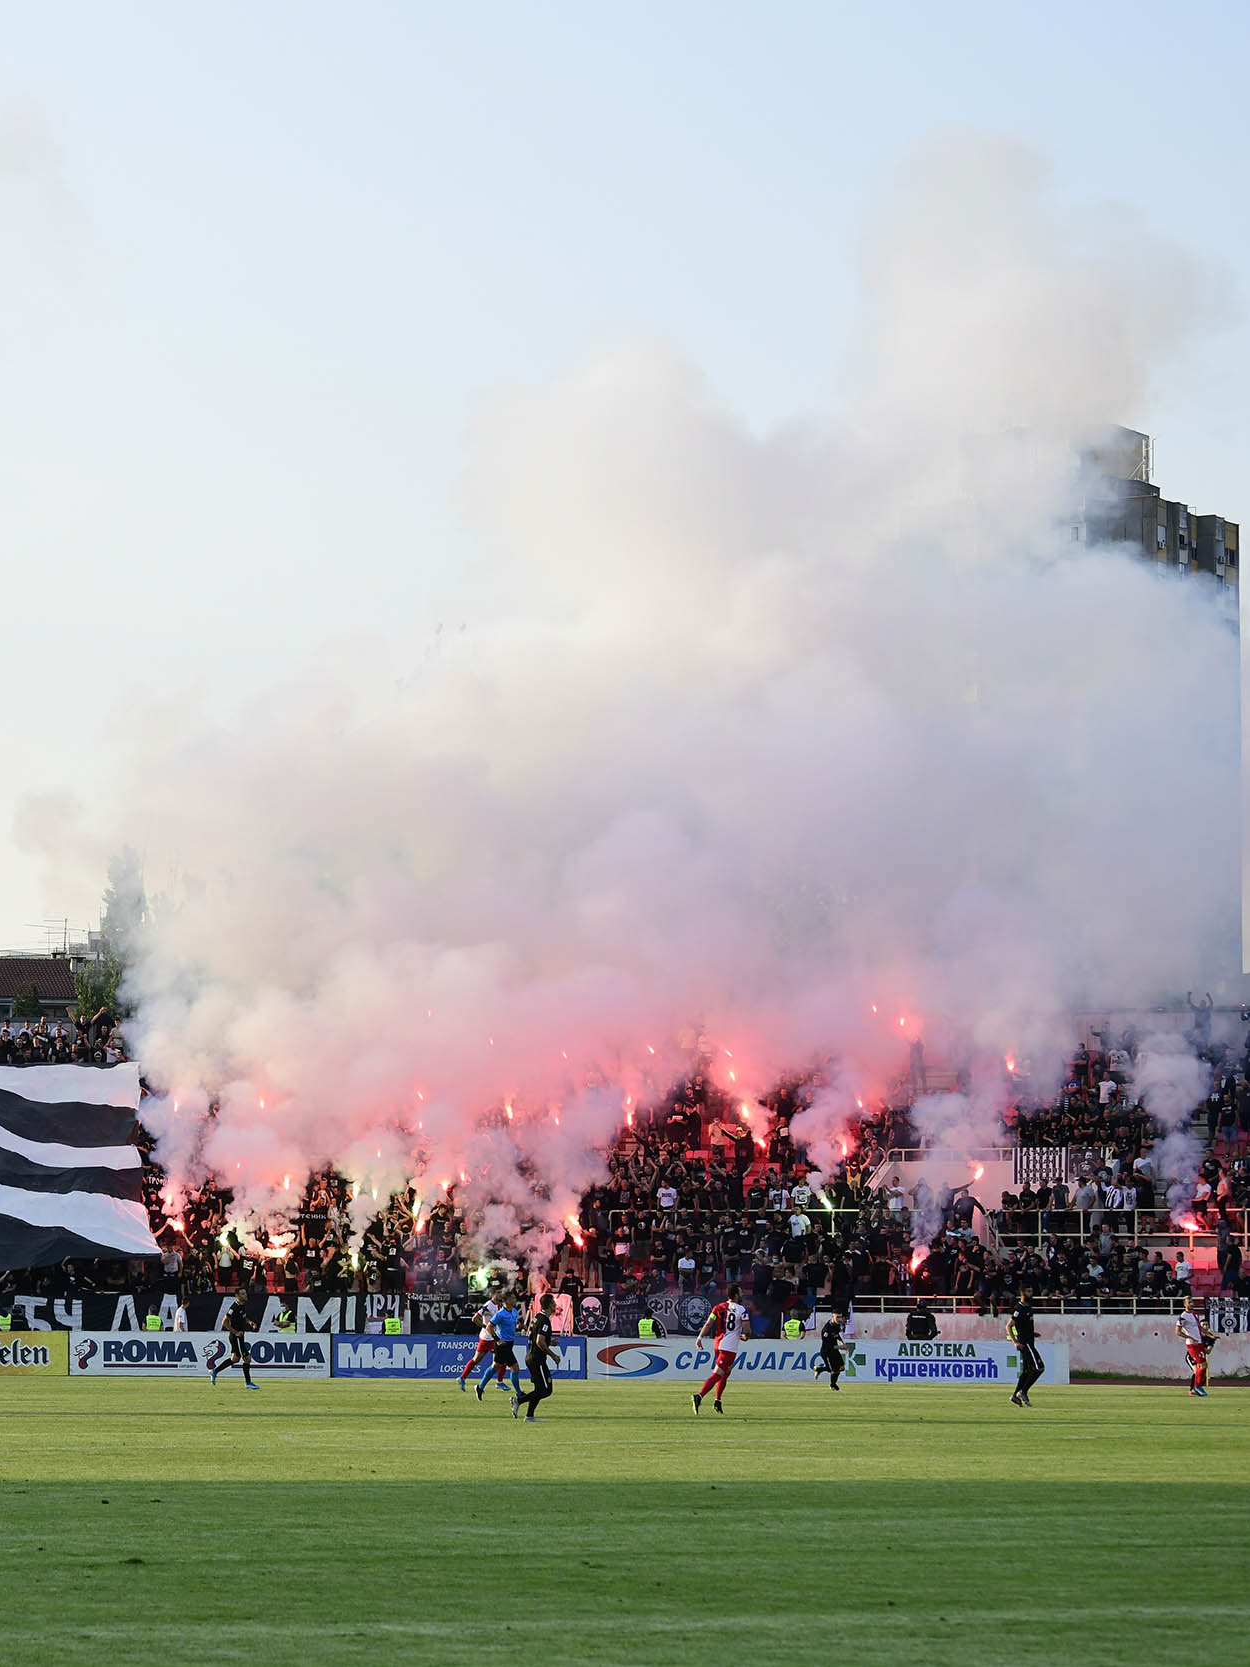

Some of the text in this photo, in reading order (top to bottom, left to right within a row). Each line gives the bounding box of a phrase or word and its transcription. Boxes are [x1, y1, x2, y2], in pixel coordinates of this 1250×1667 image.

[103, 1340, 198, 1362] ROMA
[338, 1344, 427, 1369] M&M
[456, 1353, 464, 1361] &
[898, 1343, 976, 1358] АПОТЕКА
[875, 1358, 998, 1382] Кршенковић
